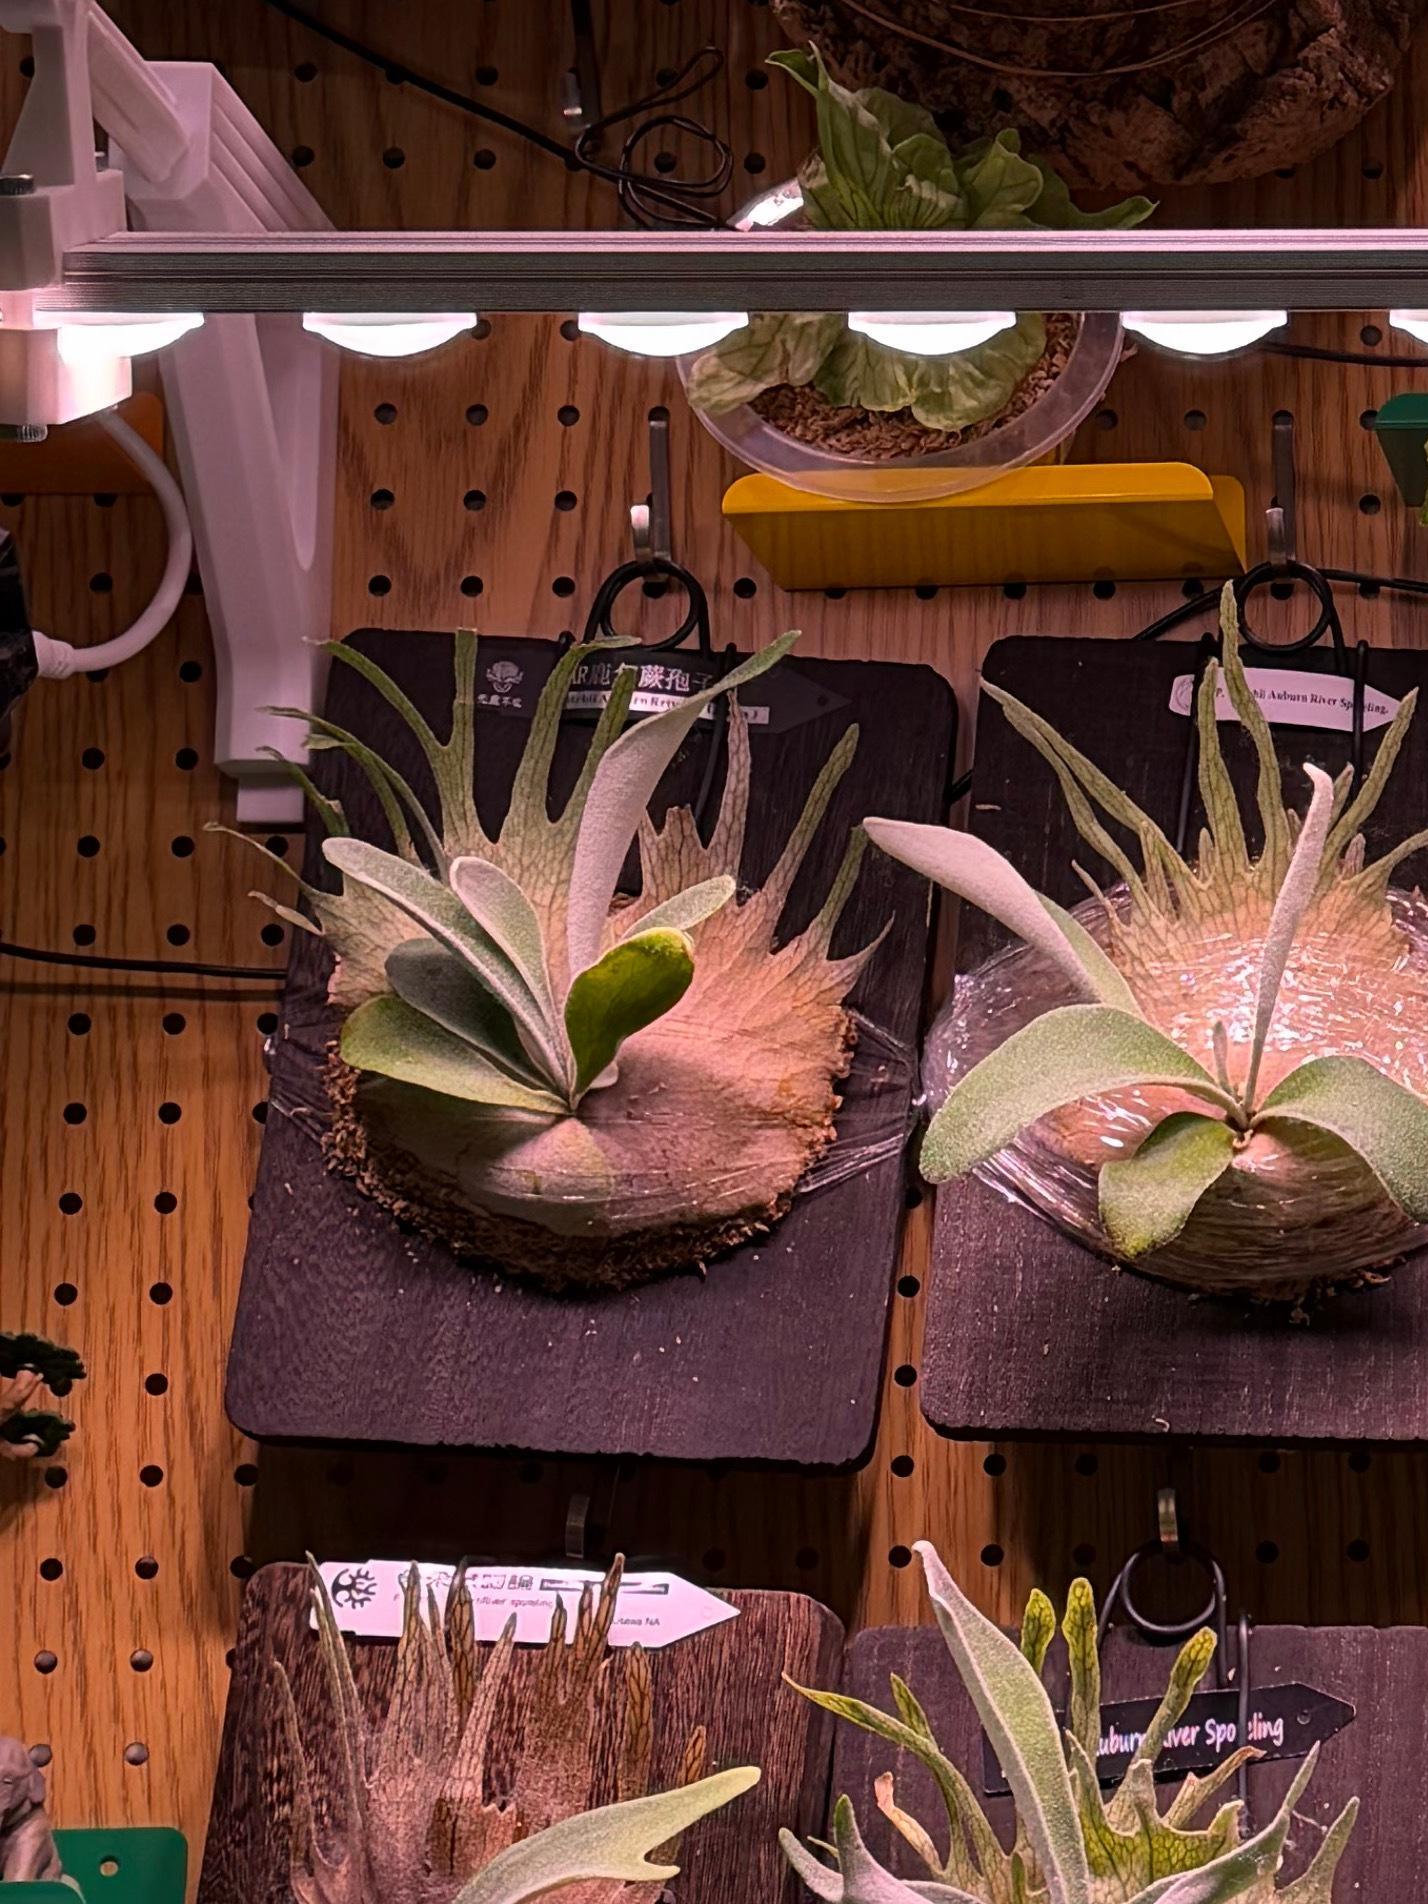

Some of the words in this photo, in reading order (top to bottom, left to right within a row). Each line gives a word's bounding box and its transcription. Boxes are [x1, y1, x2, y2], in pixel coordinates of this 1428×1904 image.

[1268, 689, 1308, 703] Auburn
[1309, 692, 1337, 706] River
[1096, 1726, 1146, 1756] uburn
